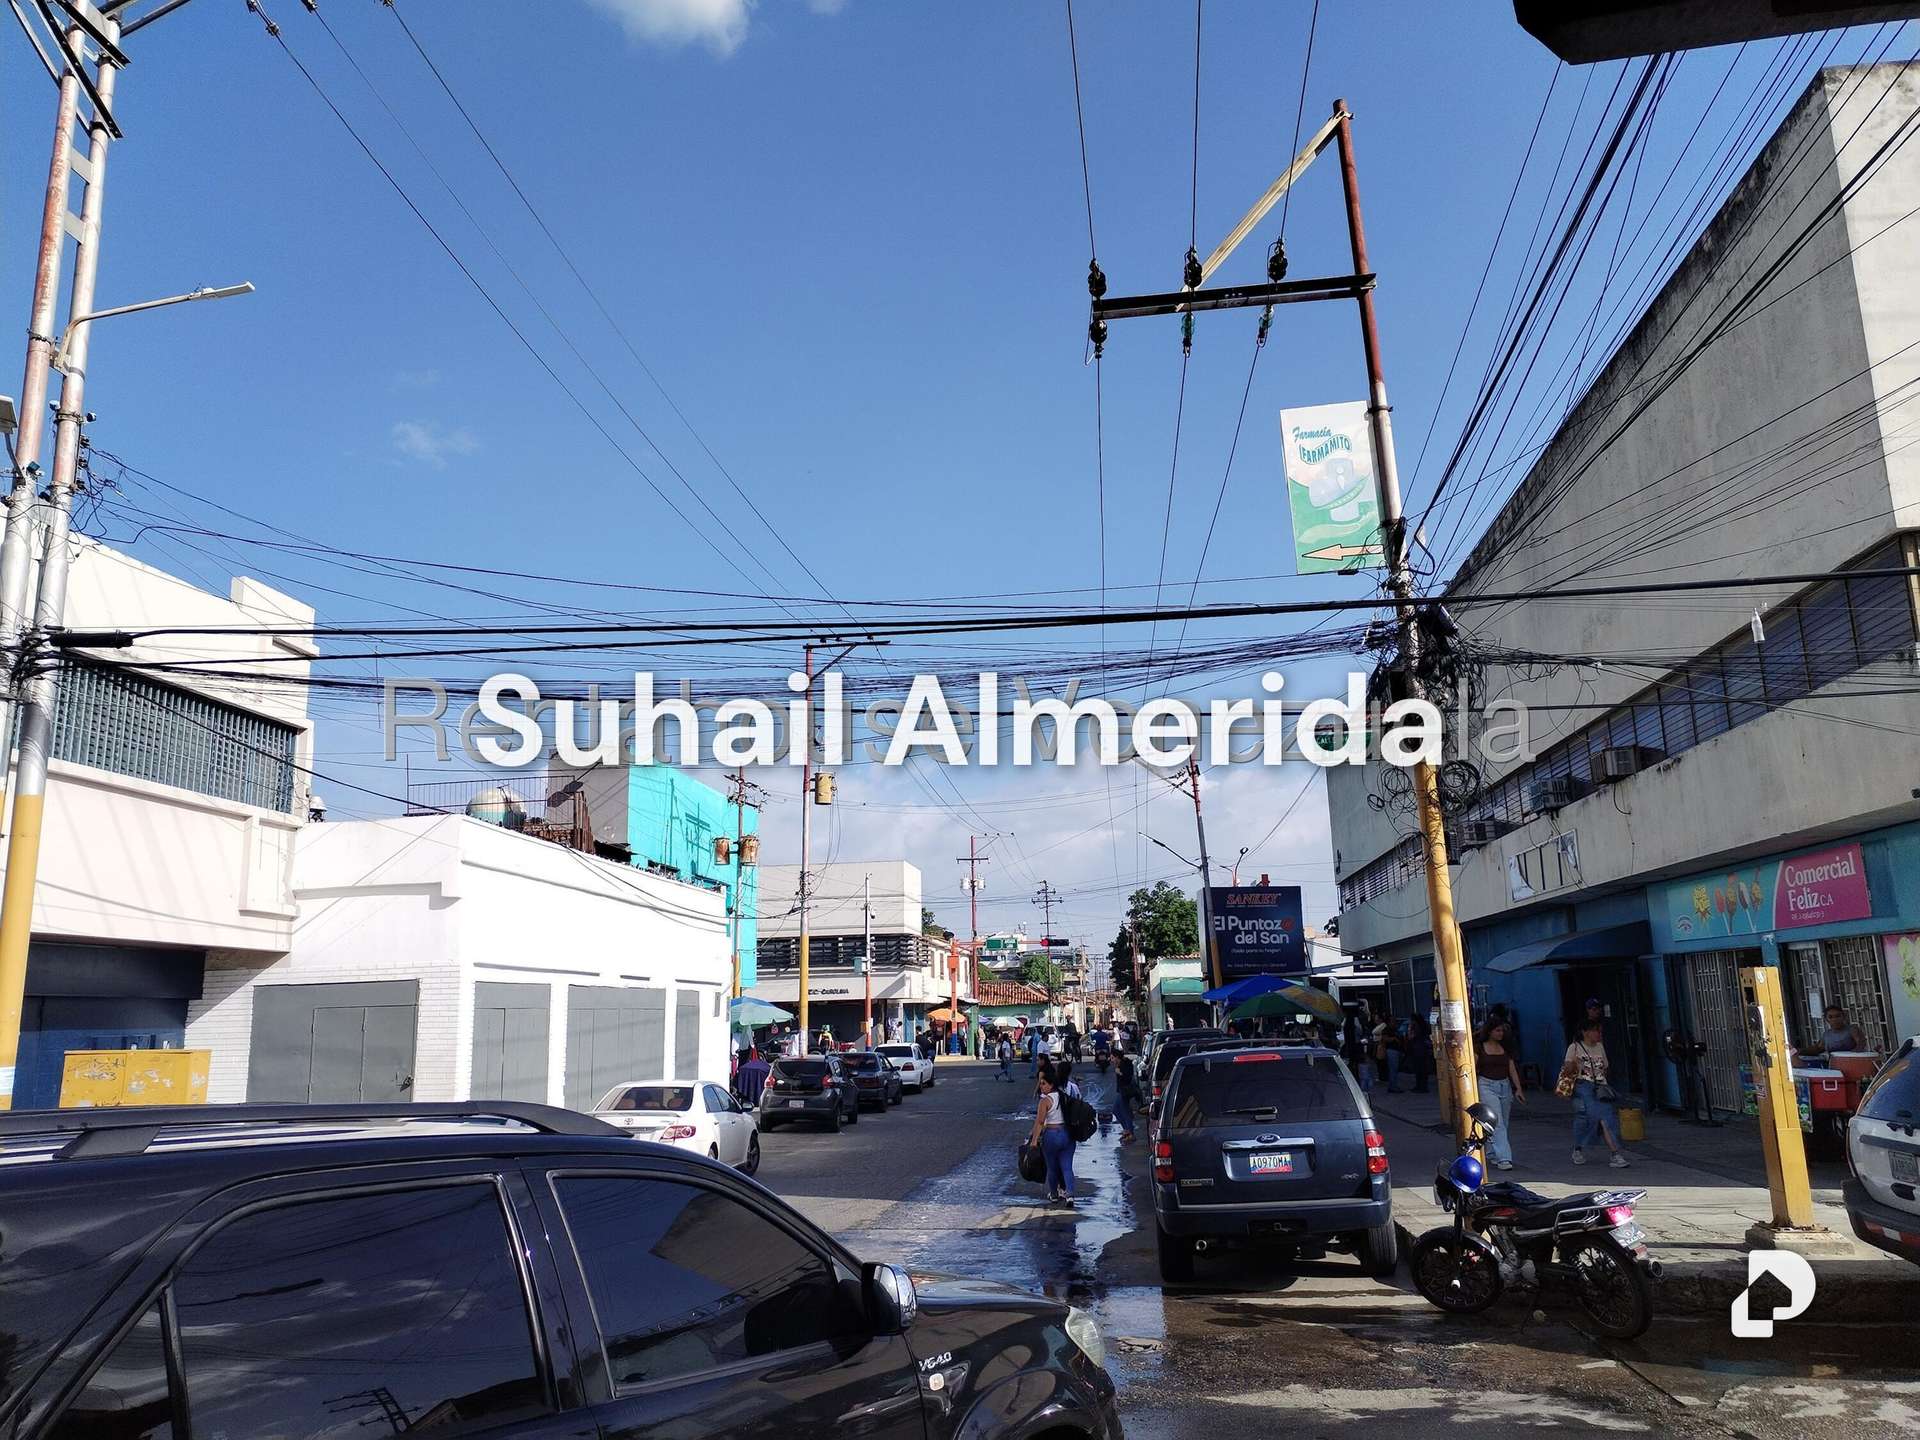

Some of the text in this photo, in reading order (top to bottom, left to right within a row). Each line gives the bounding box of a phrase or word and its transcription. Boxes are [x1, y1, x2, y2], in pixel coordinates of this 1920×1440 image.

[1292, 426, 1332, 443] Farmacia
[1785, 851, 1856, 887] Comercial
[1787, 887, 1820, 911] Feliz
[1214, 916, 1225, 930] El
[1235, 931, 1289, 944] del San
